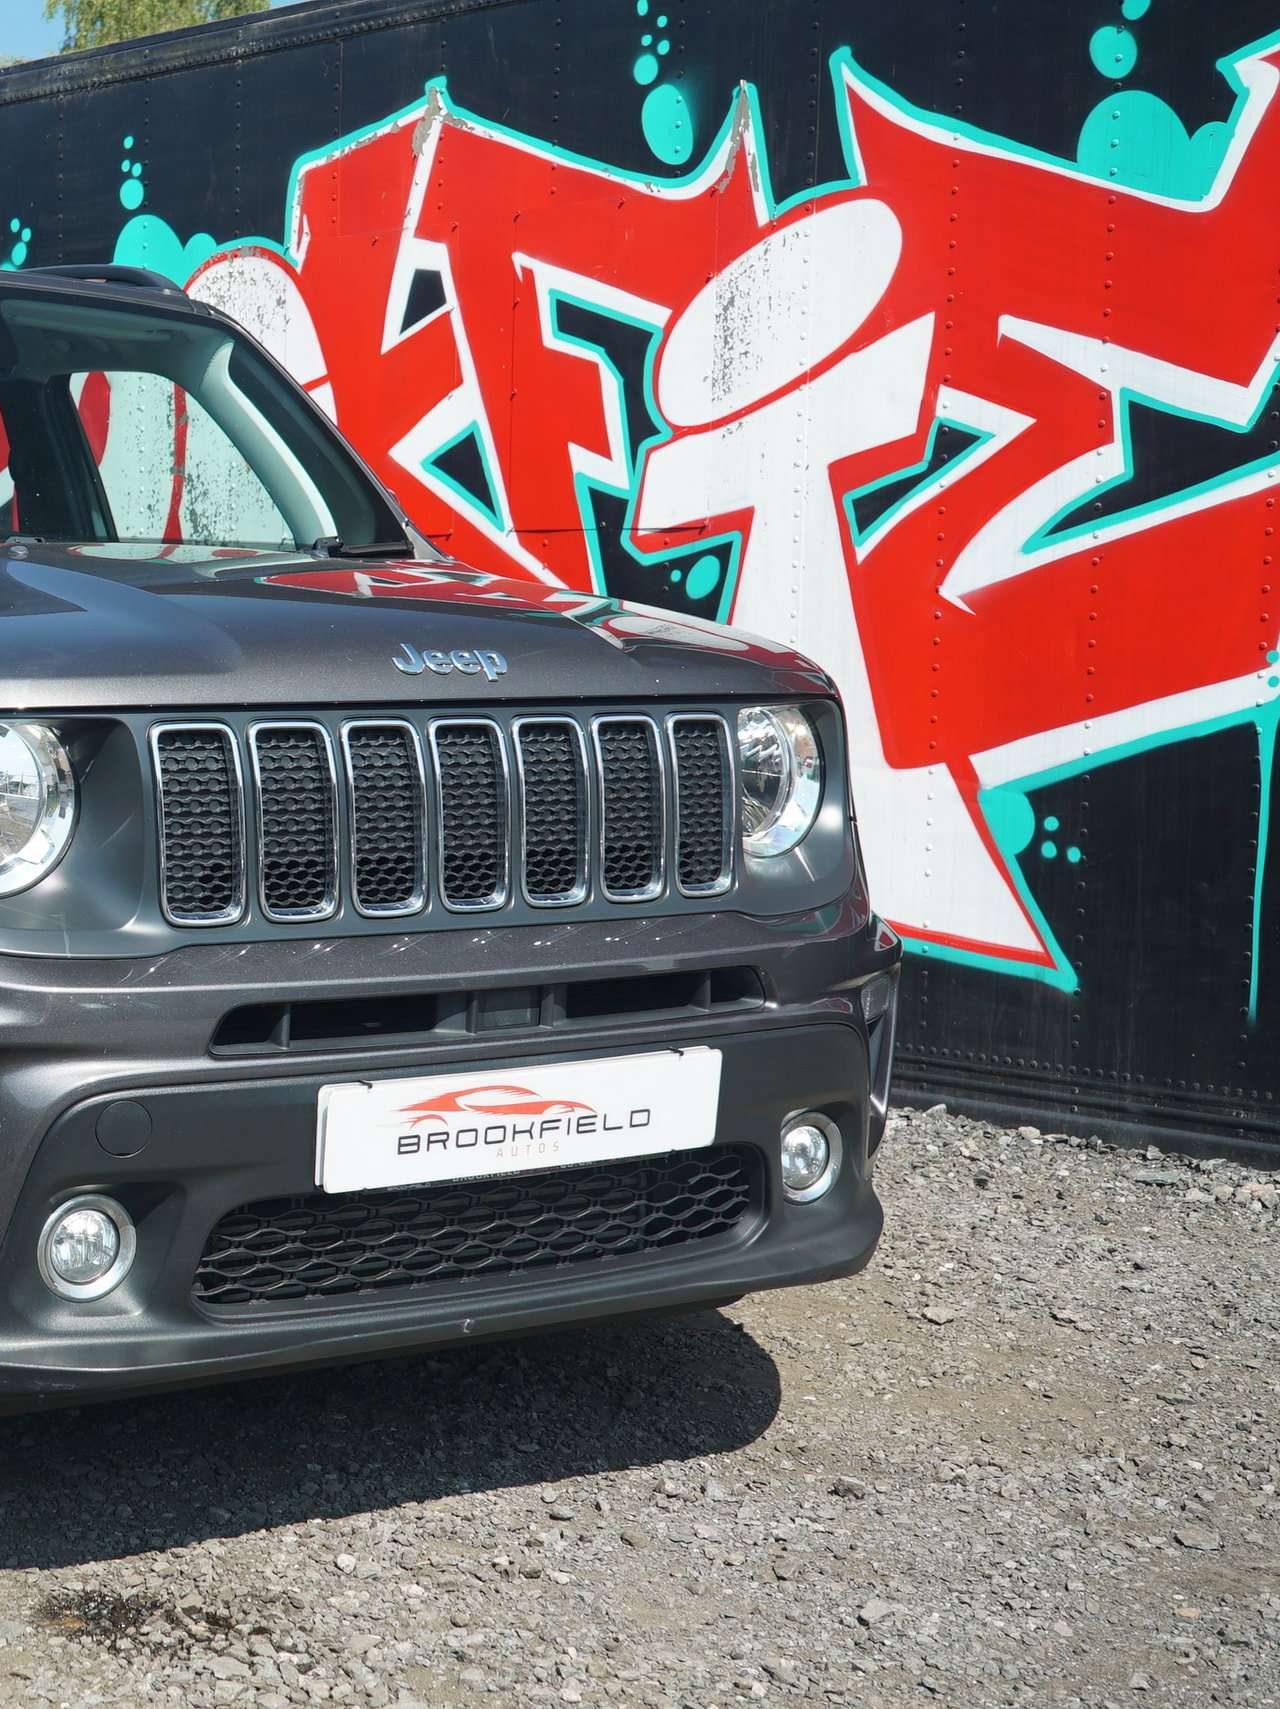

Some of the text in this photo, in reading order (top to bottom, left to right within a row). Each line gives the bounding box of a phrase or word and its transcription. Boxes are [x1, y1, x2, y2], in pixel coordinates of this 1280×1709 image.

[391, 642, 508, 682] Jeep
[396, 1108, 651, 1155] BROOKFIELD
[495, 1141, 560, 1159] AUTOS
